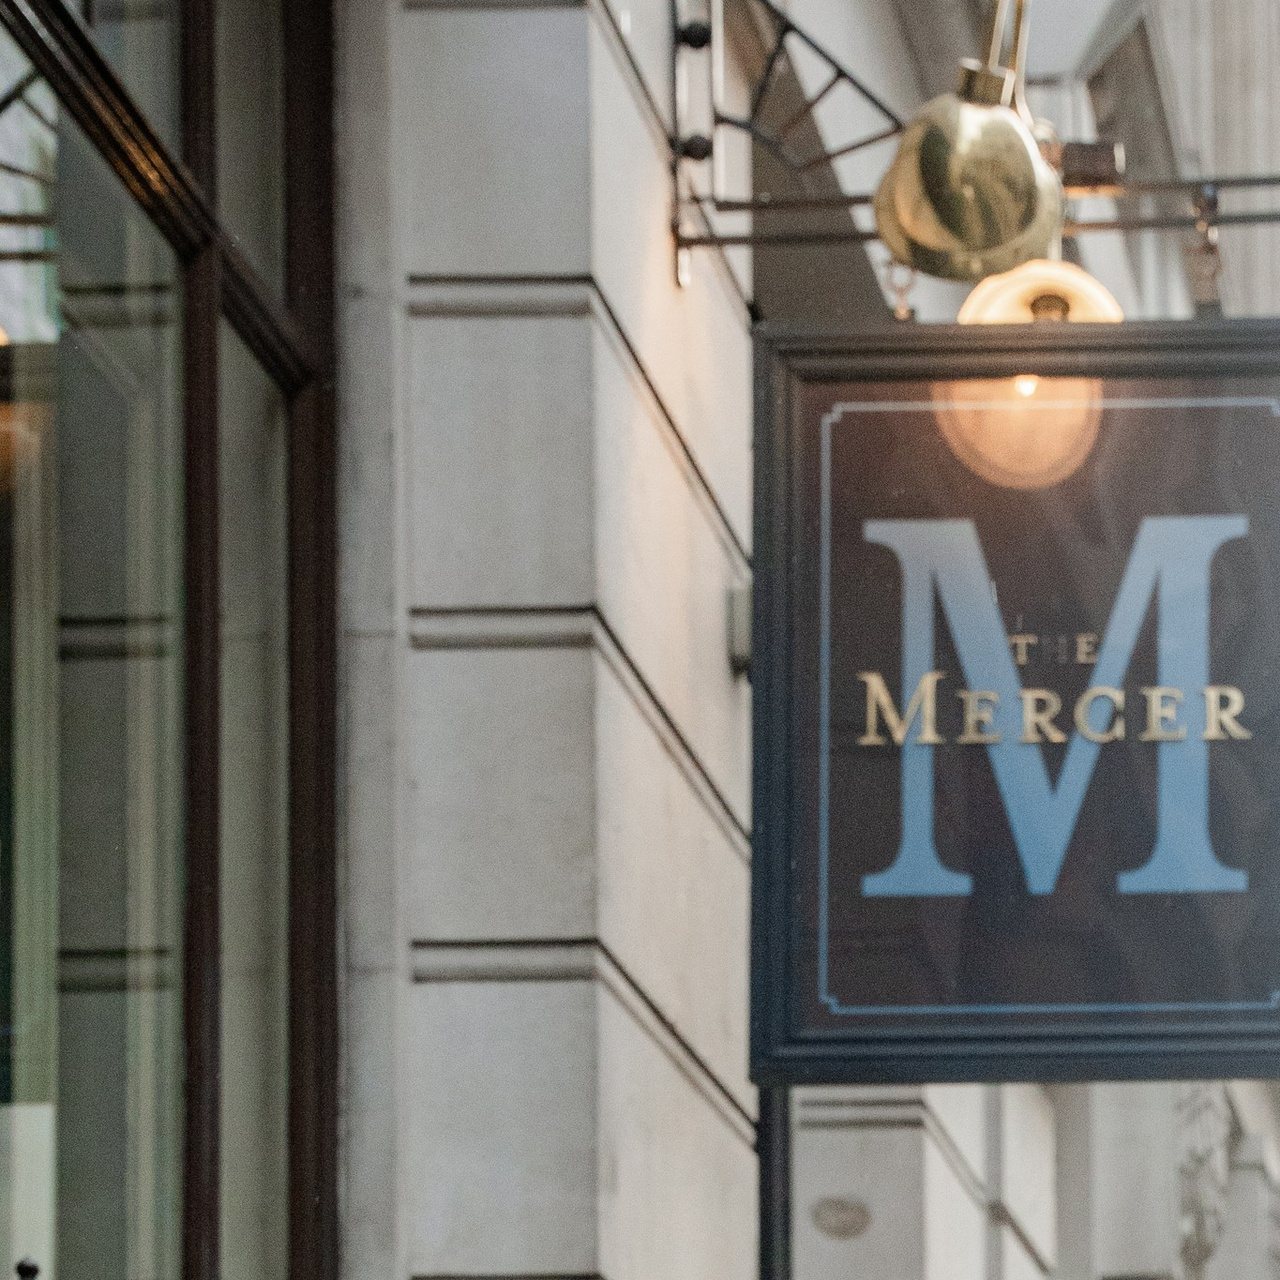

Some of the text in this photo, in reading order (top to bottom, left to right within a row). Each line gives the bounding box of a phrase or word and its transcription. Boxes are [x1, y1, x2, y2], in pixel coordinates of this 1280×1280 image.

[1008, 632, 1099, 666] TE
[858, 671, 1251, 746] MERCER
[863, 515, 1249, 896] M
